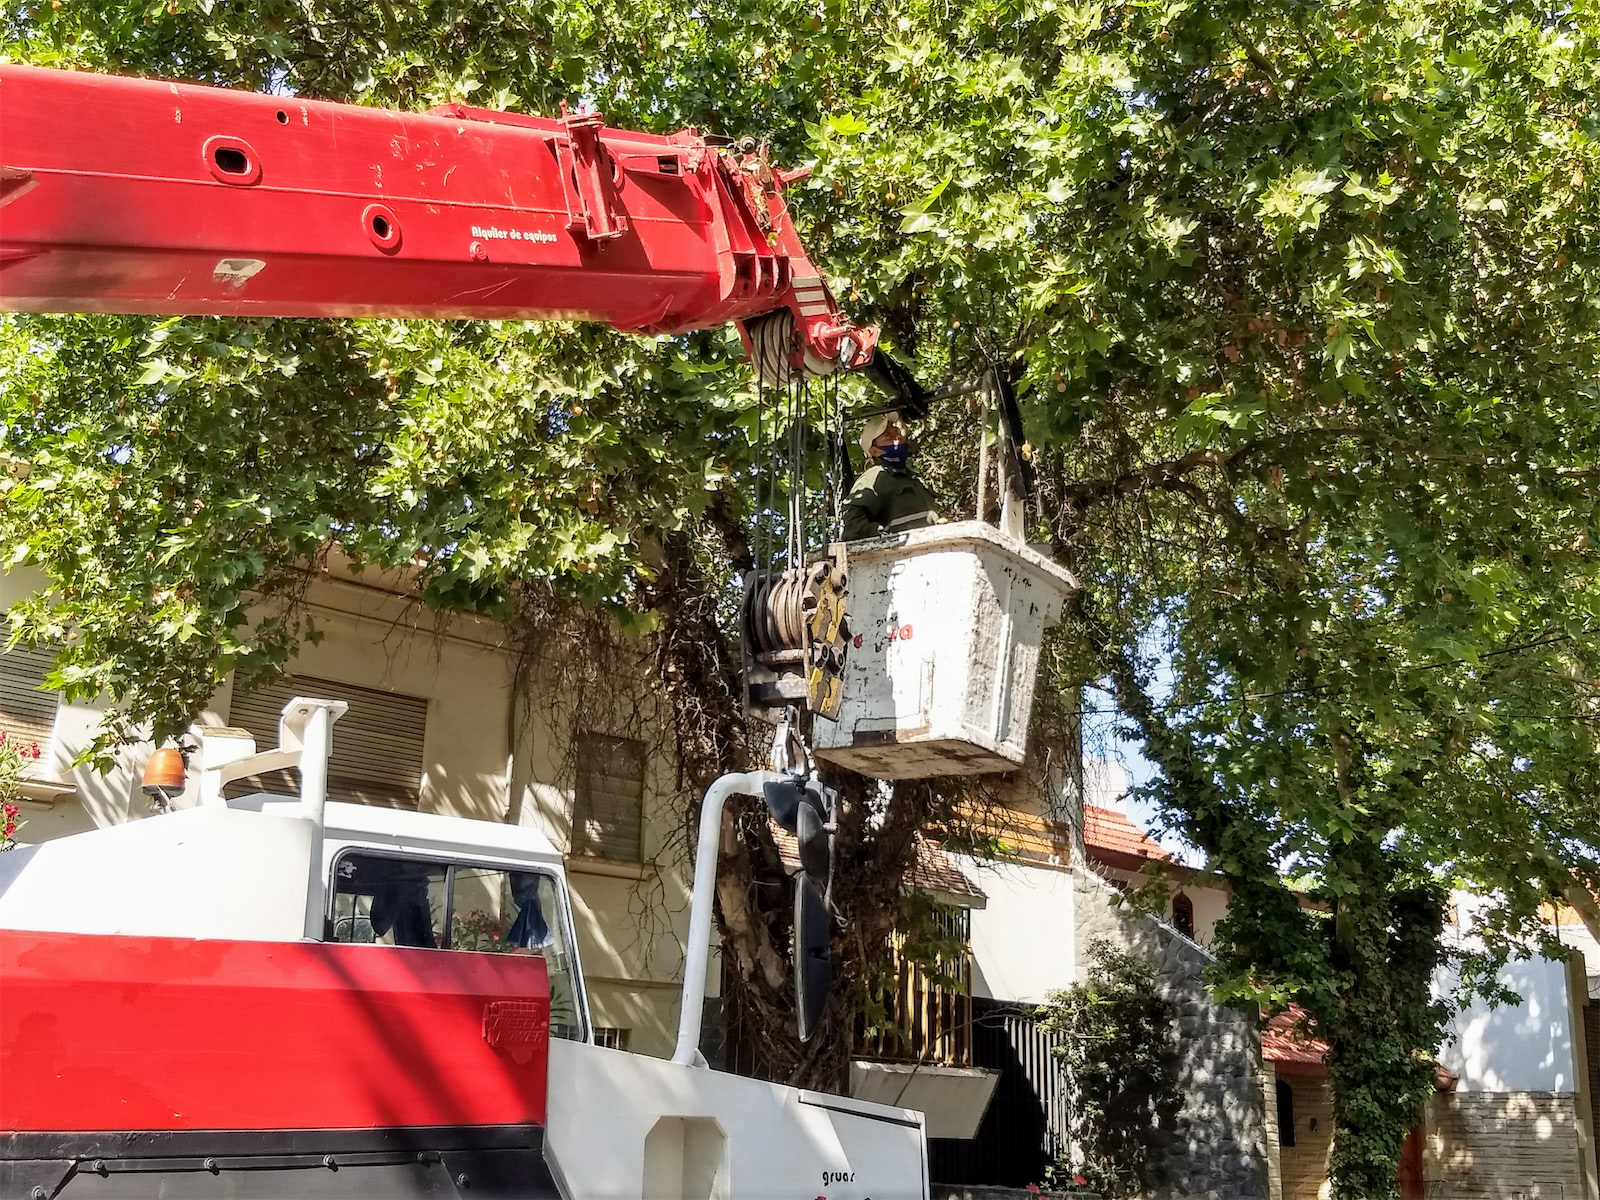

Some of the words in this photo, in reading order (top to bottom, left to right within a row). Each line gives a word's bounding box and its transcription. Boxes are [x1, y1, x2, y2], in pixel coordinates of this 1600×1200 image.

[471, 226, 508, 241] Alquiler
[509, 228, 522, 240] de
[523, 229, 558, 244] equipos
